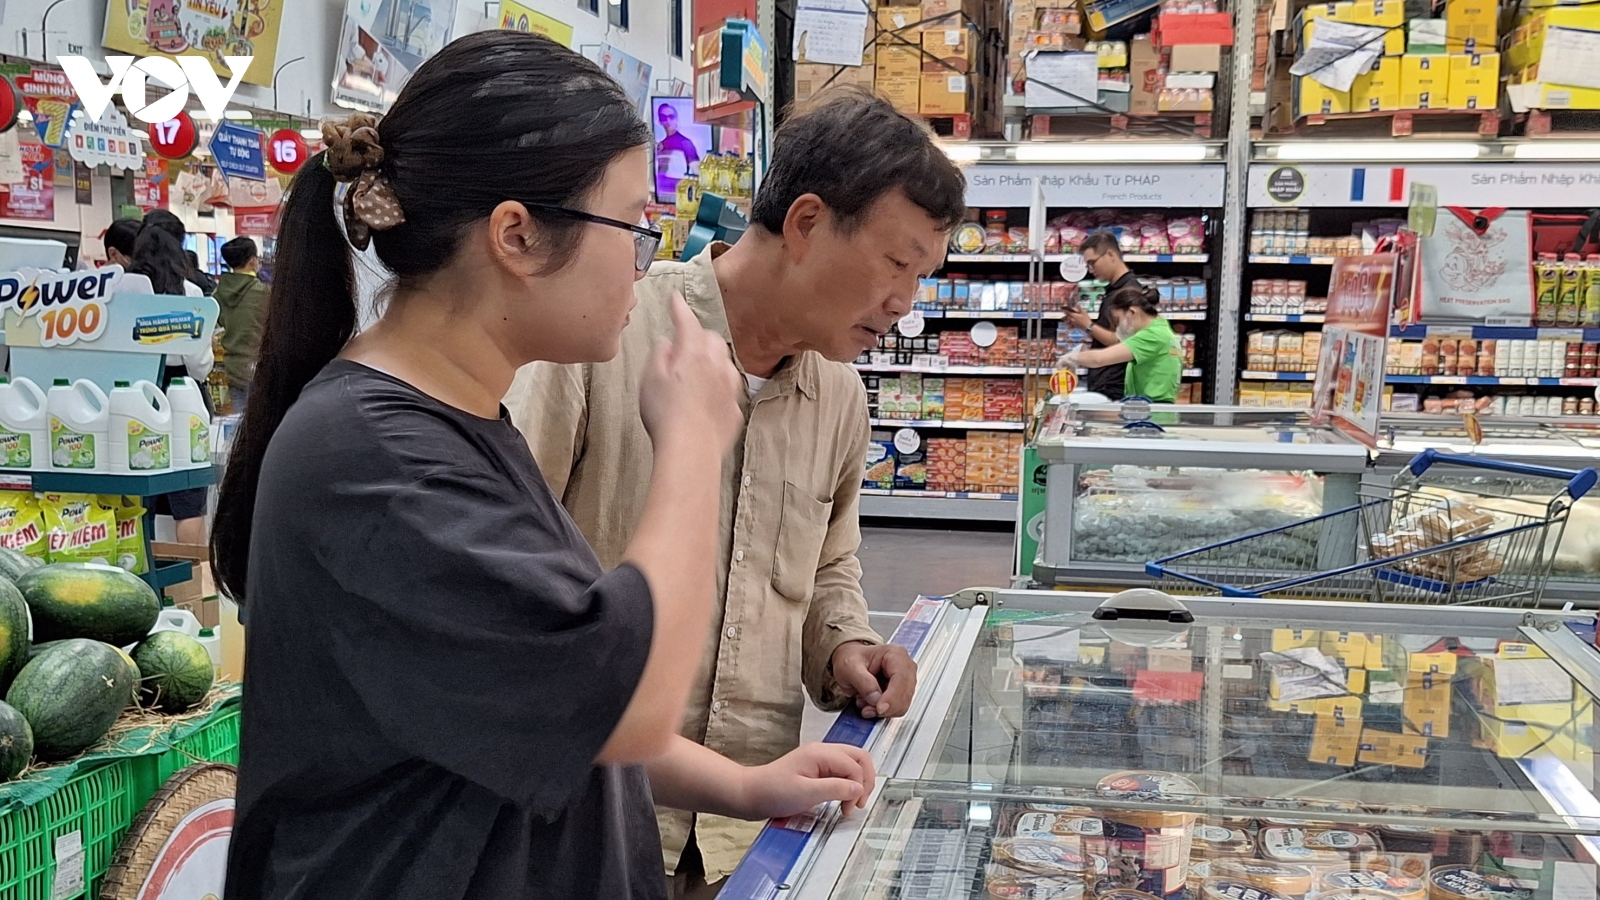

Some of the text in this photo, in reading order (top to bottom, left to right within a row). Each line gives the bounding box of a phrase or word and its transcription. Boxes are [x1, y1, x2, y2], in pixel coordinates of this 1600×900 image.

[68, 43, 83, 55] EXIT
[23, 82, 47, 95] SINH
[37, 100, 70, 146] 7
[99, 123, 112, 135] THU
[155, 118, 181, 145] 17
[273, 139, 297, 163] 16
[1125, 172, 1160, 186] PHÁP
[1102, 193, 1162, 201] French Products
[0, 271, 115, 311] Power
[1455, 298, 1497, 306] PRESERVATION
[42, 303, 101, 341] 100
[58, 434, 85, 446] Power
[139, 436, 165, 449] Power
[5, 443, 19, 451] 100
[69, 443, 83, 451] 100
[150, 444, 164, 453] 100
